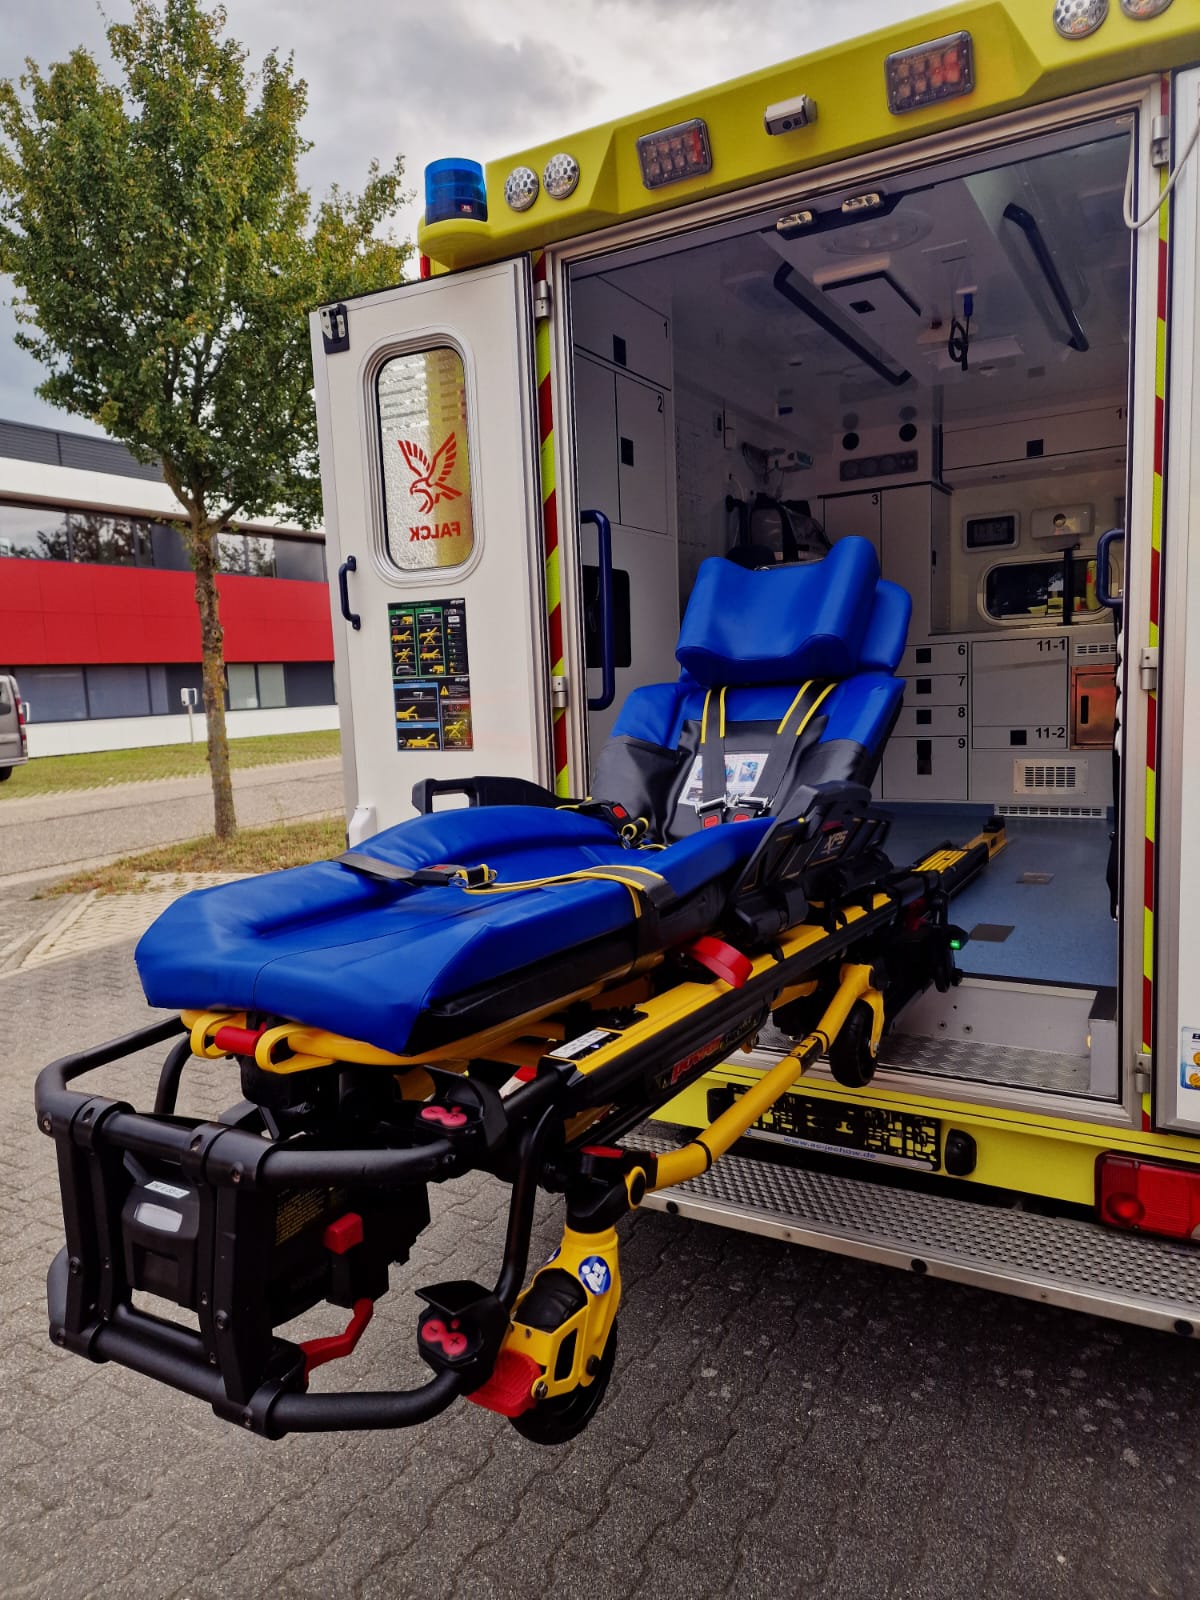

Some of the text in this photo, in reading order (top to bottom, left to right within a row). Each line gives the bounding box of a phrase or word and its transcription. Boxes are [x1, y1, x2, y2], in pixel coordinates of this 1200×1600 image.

[663, 320, 668, 340] 1
[657, 395, 663, 413] 2
[872, 494, 879, 505] 3
[958, 644, 966, 656] 6
[1036, 639, 1066, 652] 11-1
[958, 675, 966, 687] 7
[958, 706, 966, 718] 8
[1035, 727, 1066, 739] 11-2
[958, 738, 966, 749] 9
